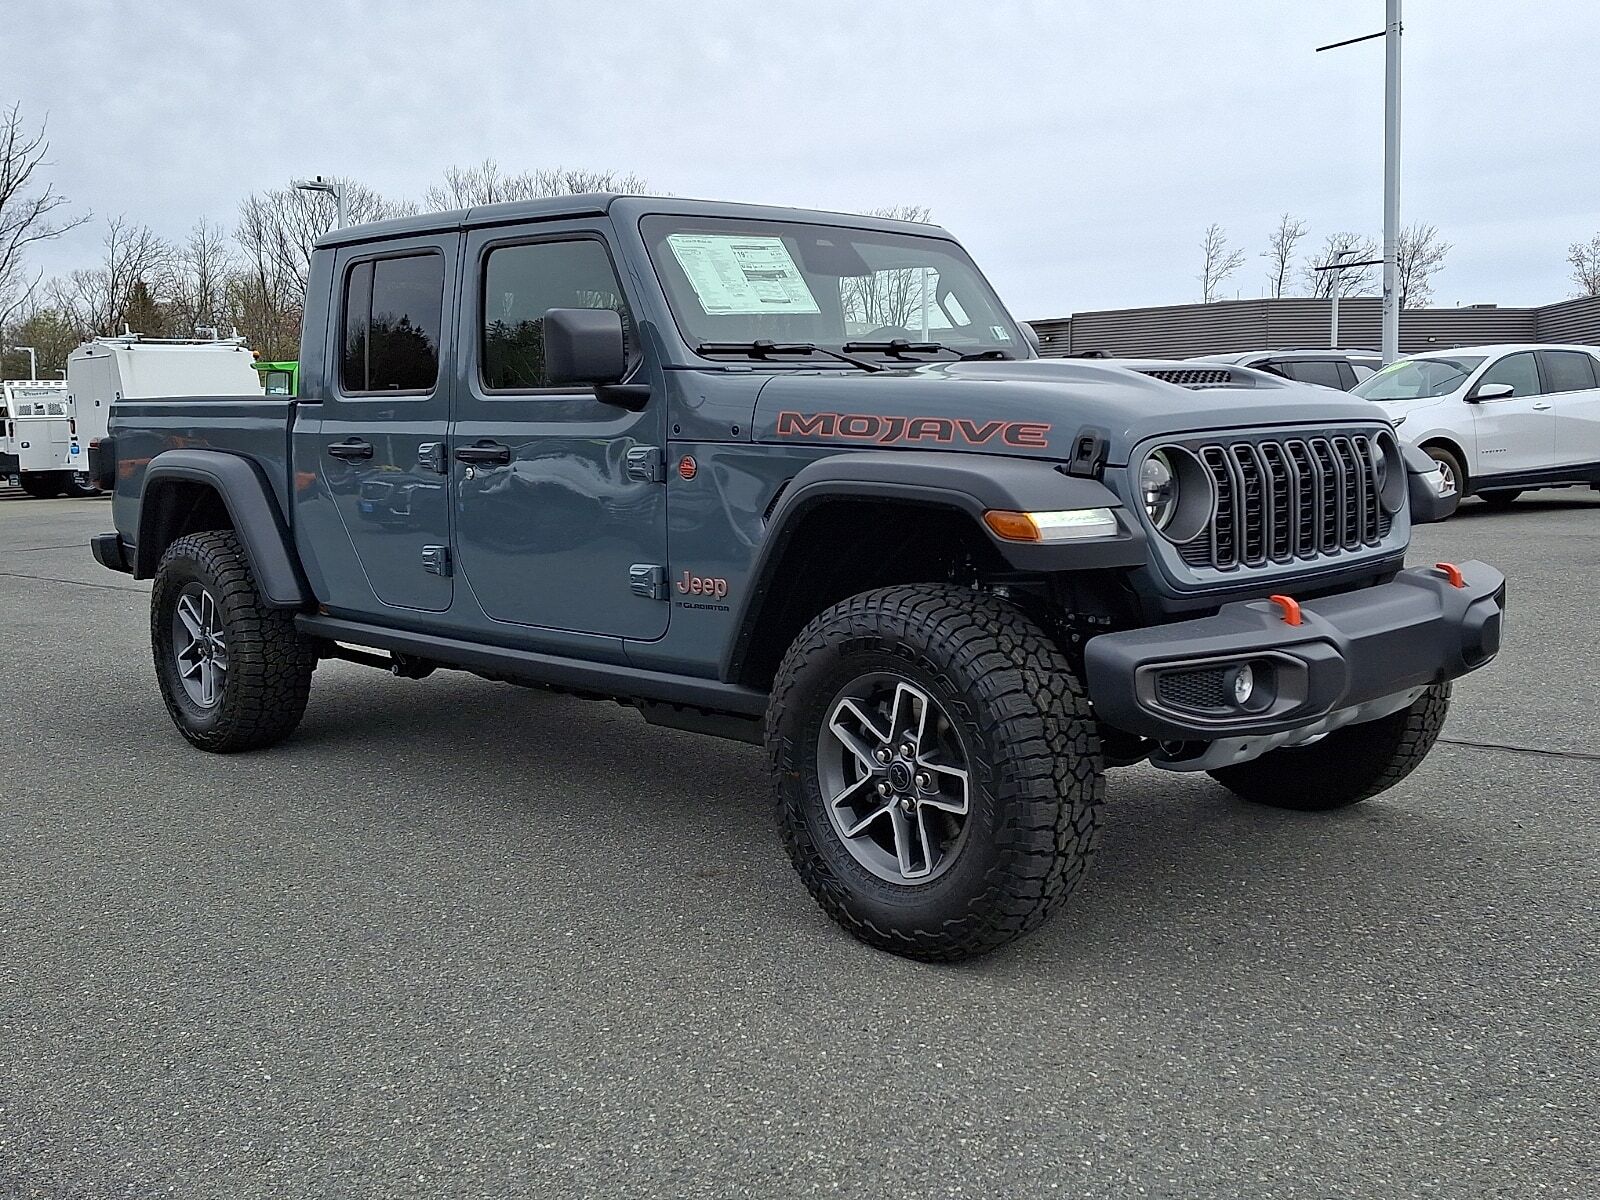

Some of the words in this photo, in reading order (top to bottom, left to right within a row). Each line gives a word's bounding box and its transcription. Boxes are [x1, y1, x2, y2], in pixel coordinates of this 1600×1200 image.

[778, 411, 1050, 447] MOJAVE
[676, 570, 728, 601] Jeep
[683, 602, 730, 612] GLADIATOR
